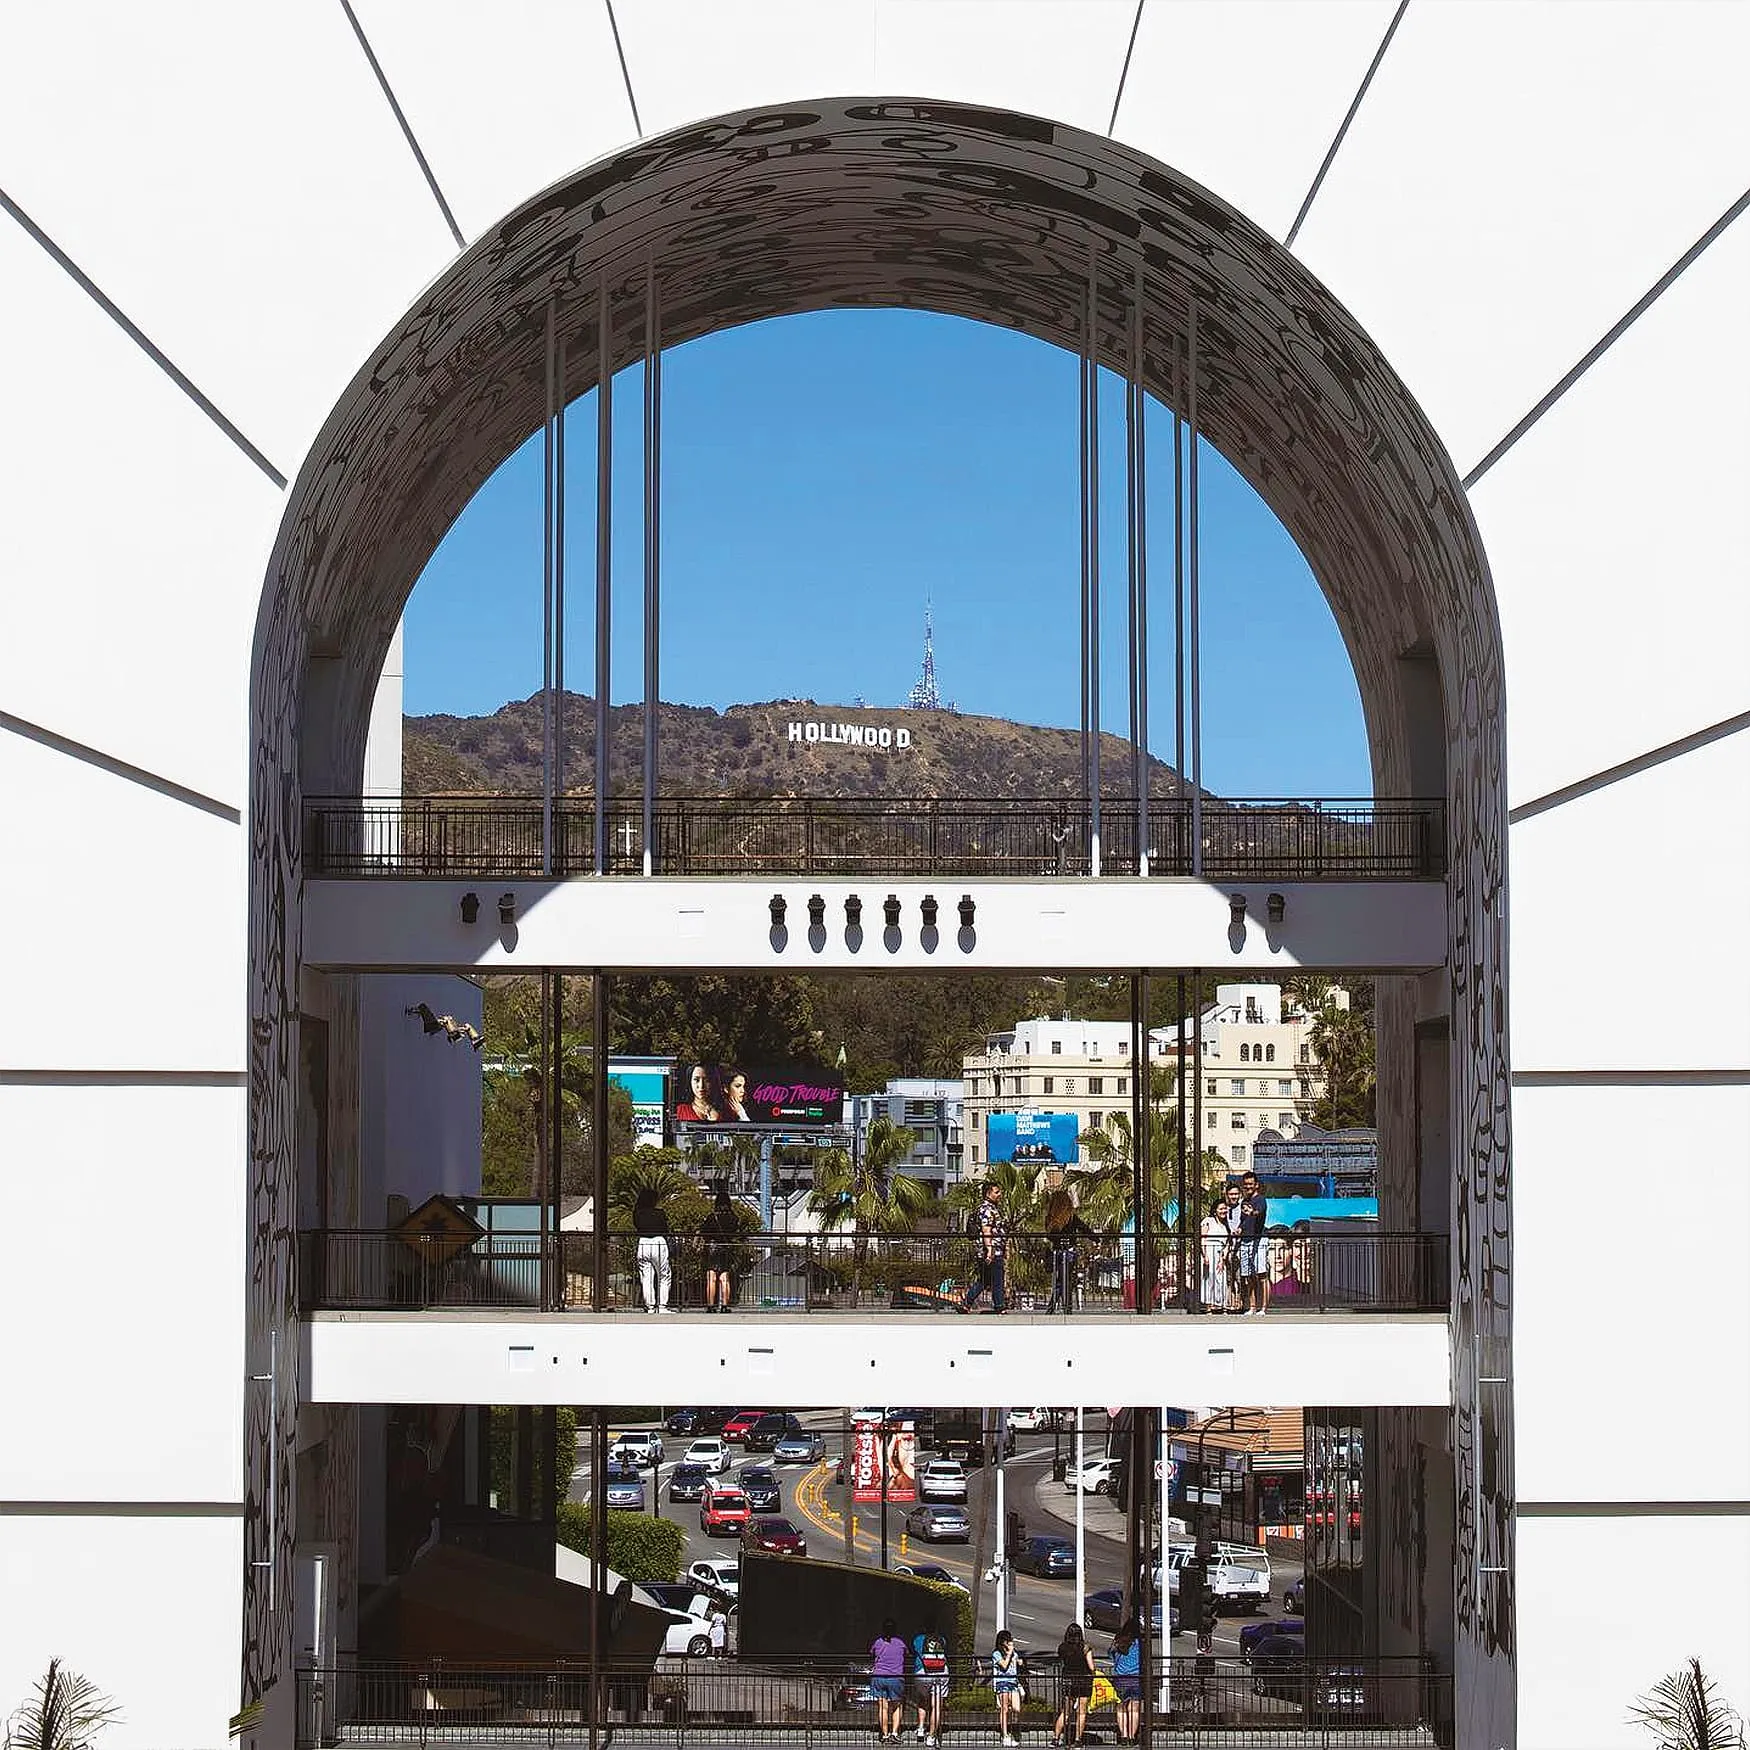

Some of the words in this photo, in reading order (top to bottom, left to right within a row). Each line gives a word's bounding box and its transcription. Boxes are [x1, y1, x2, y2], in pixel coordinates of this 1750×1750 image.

[788, 722, 911, 748] HOLLYWOOD
[752, 1083, 789, 1103] GOOD
[789, 1084, 841, 1103] TROUBLE
